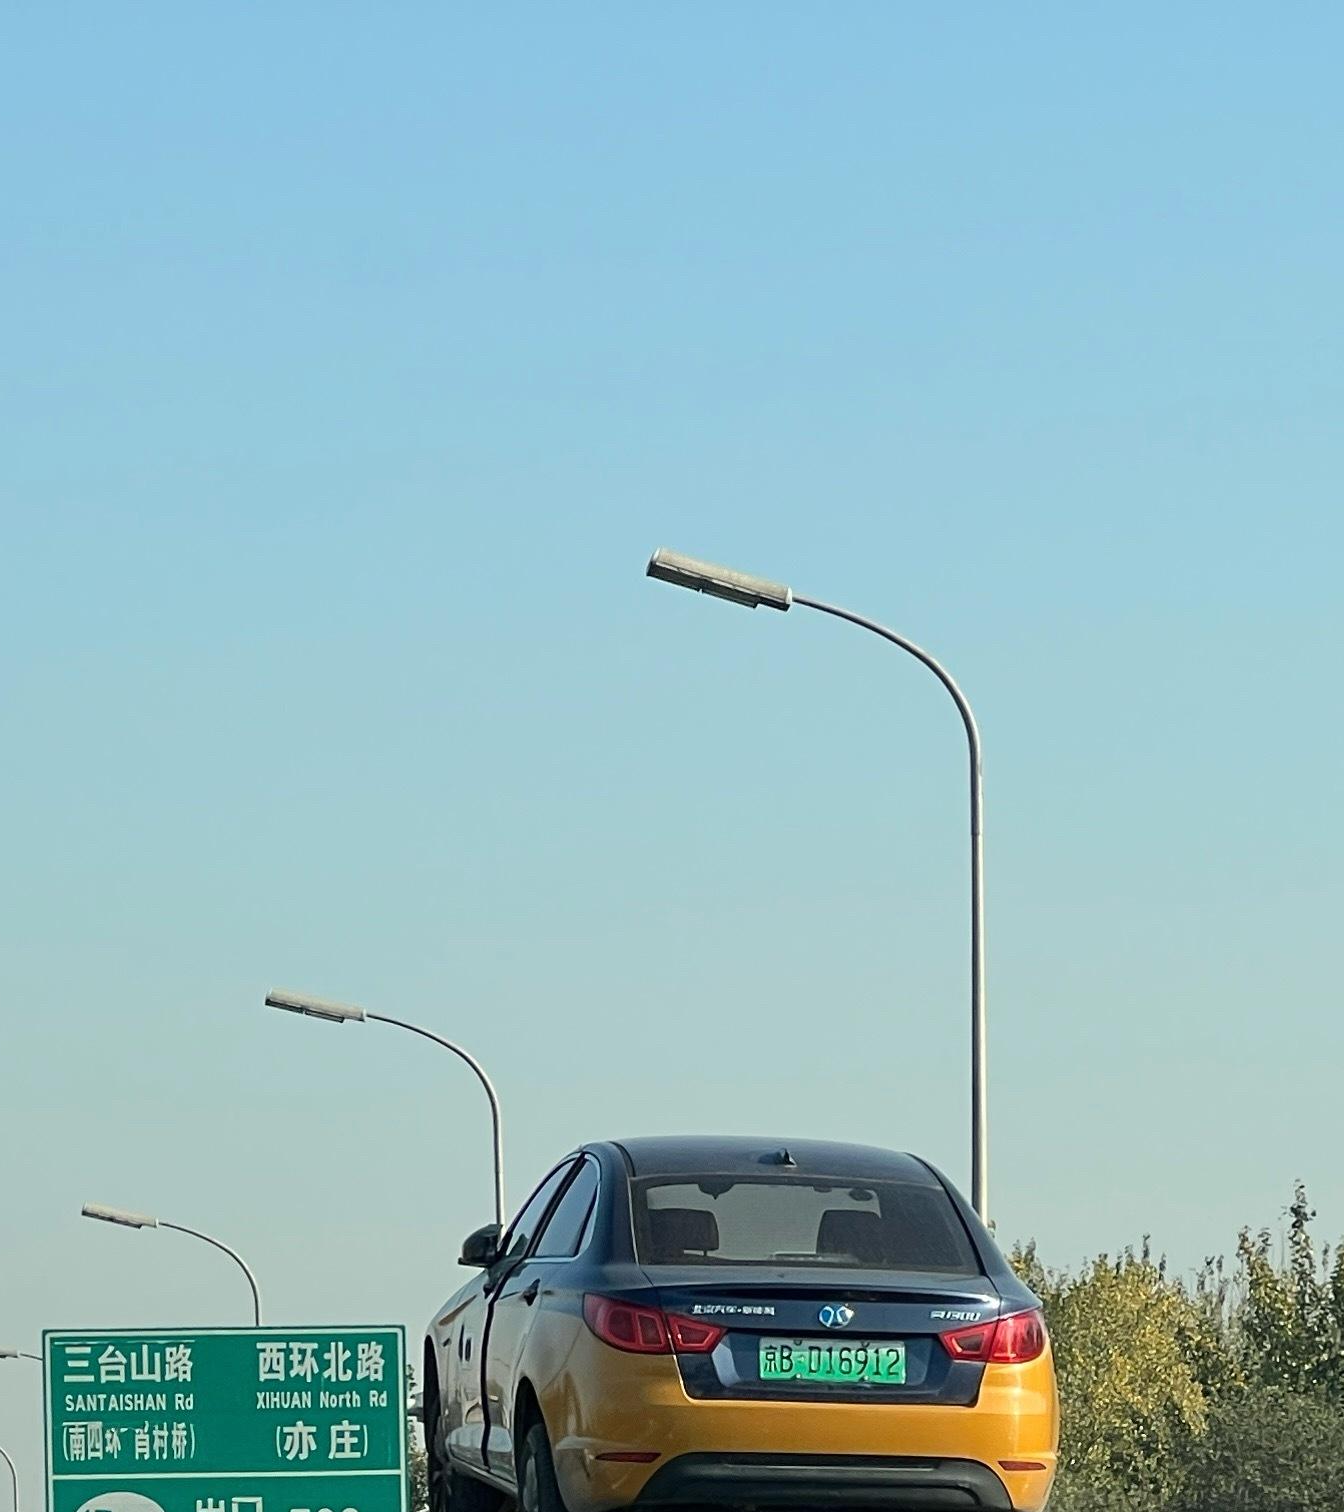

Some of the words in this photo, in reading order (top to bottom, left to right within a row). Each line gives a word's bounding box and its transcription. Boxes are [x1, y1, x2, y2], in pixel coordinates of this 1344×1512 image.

[63, 1345, 195, 1383] 三台山路
[256, 1341, 385, 1383] 西环北路
[65, 1393, 166, 1412] SANTAISHAN
[175, 1393, 194, 1411] Rd
[256, 1391, 311, 1410] XIHUAN
[319, 1391, 361, 1409] North
[369, 1390, 388, 1408] Rd
